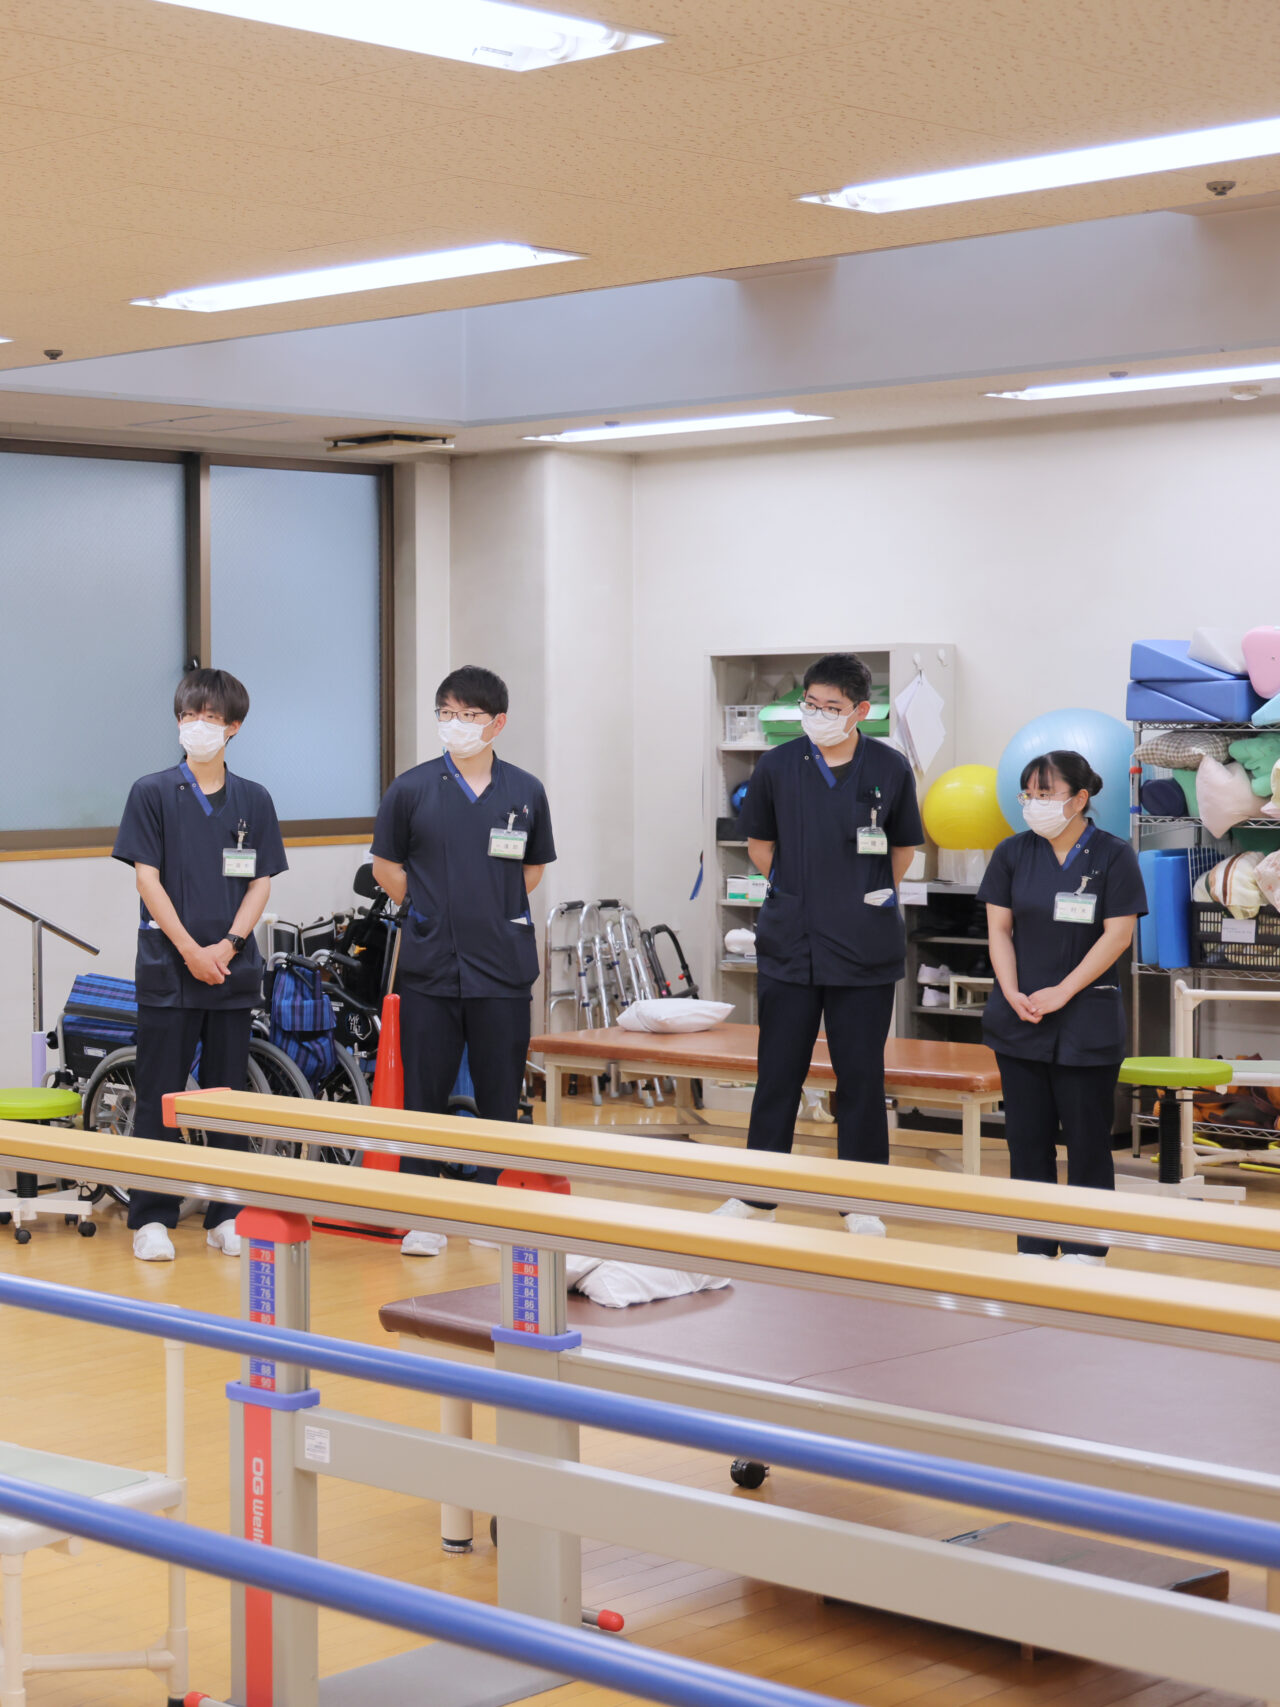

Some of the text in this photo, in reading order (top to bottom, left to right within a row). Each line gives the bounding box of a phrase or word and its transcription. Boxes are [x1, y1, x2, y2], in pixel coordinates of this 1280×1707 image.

[260, 1250, 271, 1261] 70
[523, 1253, 534, 1263] 78
[260, 1263, 271, 1273] 72
[524, 1265, 534, 1275] 80
[260, 1276, 271, 1286] 74
[524, 1276, 534, 1286] 82
[260, 1288, 271, 1299] 76
[524, 1288, 535, 1298] 84
[260, 1301, 271, 1312] 78
[524, 1300, 535, 1309] 86
[524, 1311, 535, 1321] 88
[524, 1323, 535, 1332] 90
[252, 1456, 265, 1496] OG
